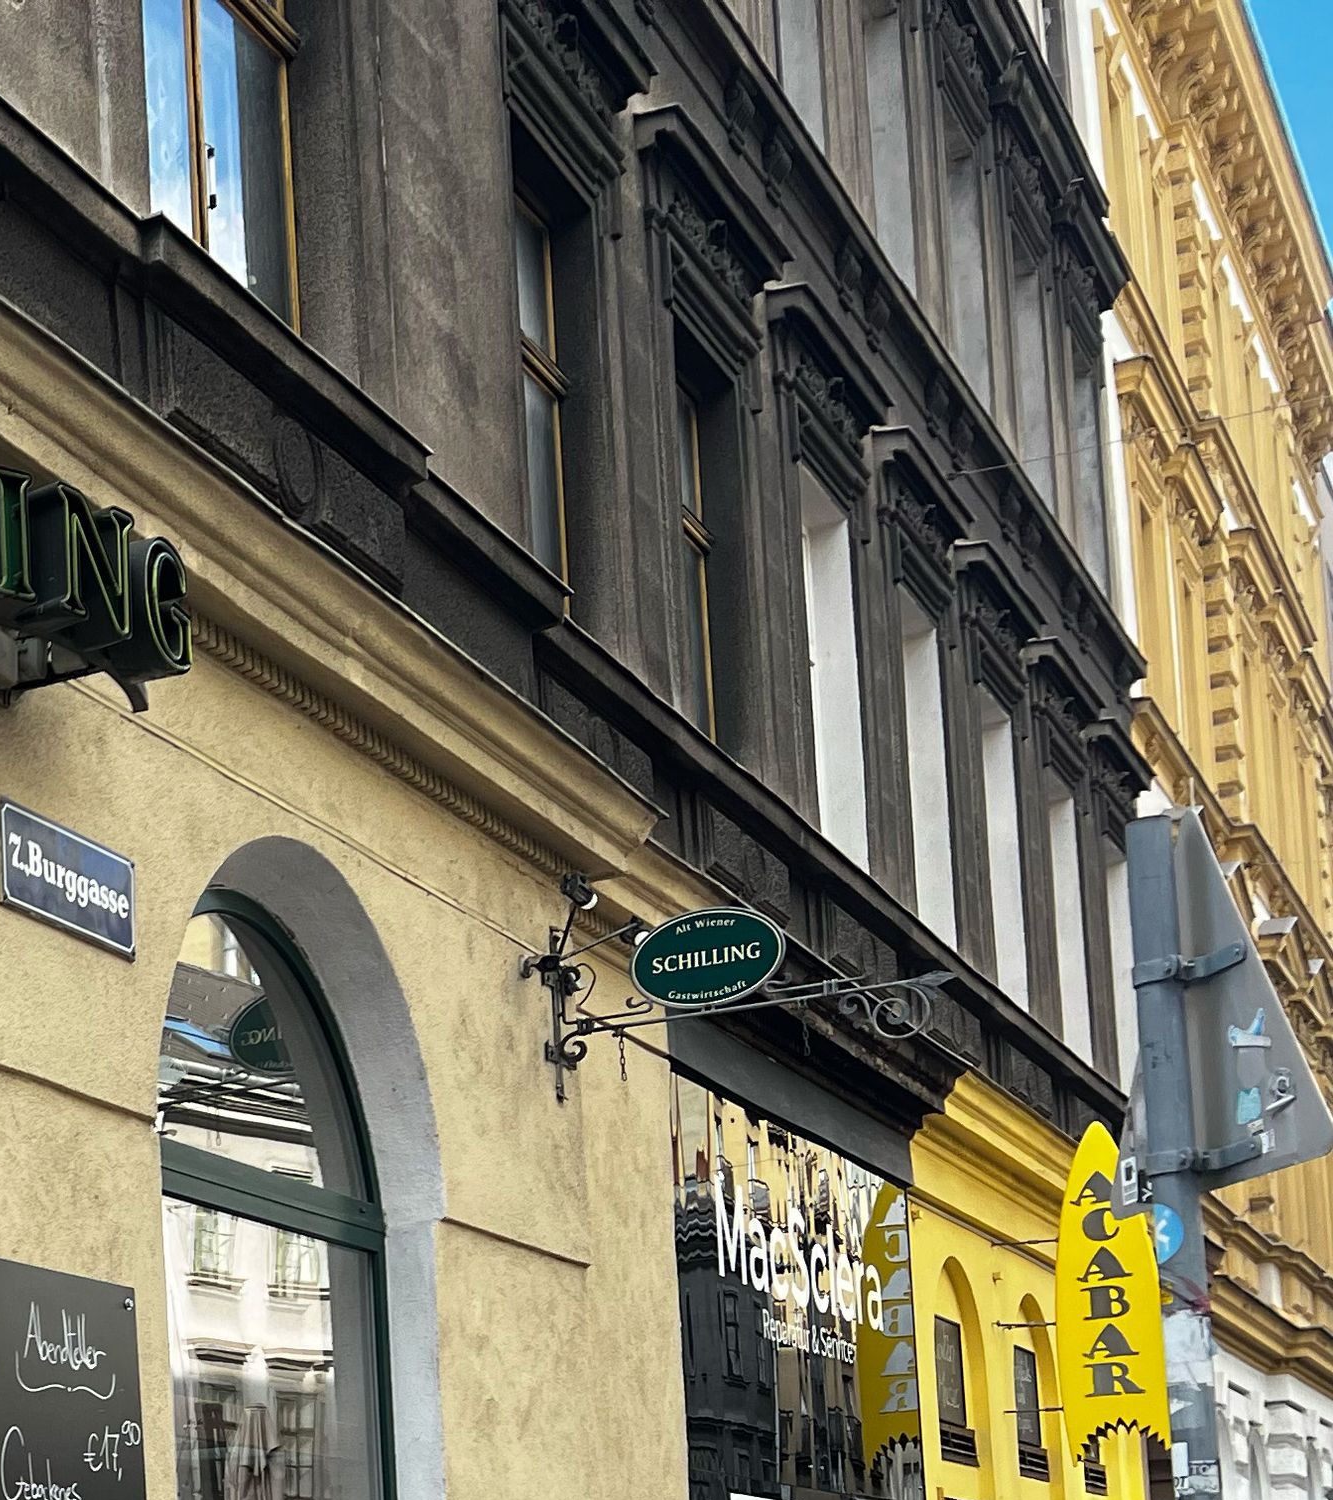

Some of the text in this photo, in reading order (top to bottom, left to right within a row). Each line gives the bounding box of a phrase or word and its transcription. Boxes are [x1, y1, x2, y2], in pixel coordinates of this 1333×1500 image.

[675, 917, 736, 936] Alt Wiener
[652, 942, 761, 975] SCHILLING
[668, 979, 747, 1001] Gastwirtschaft
[715, 1170, 884, 1333] MacSclera
[1070, 1170, 1146, 1398] ACABAR
